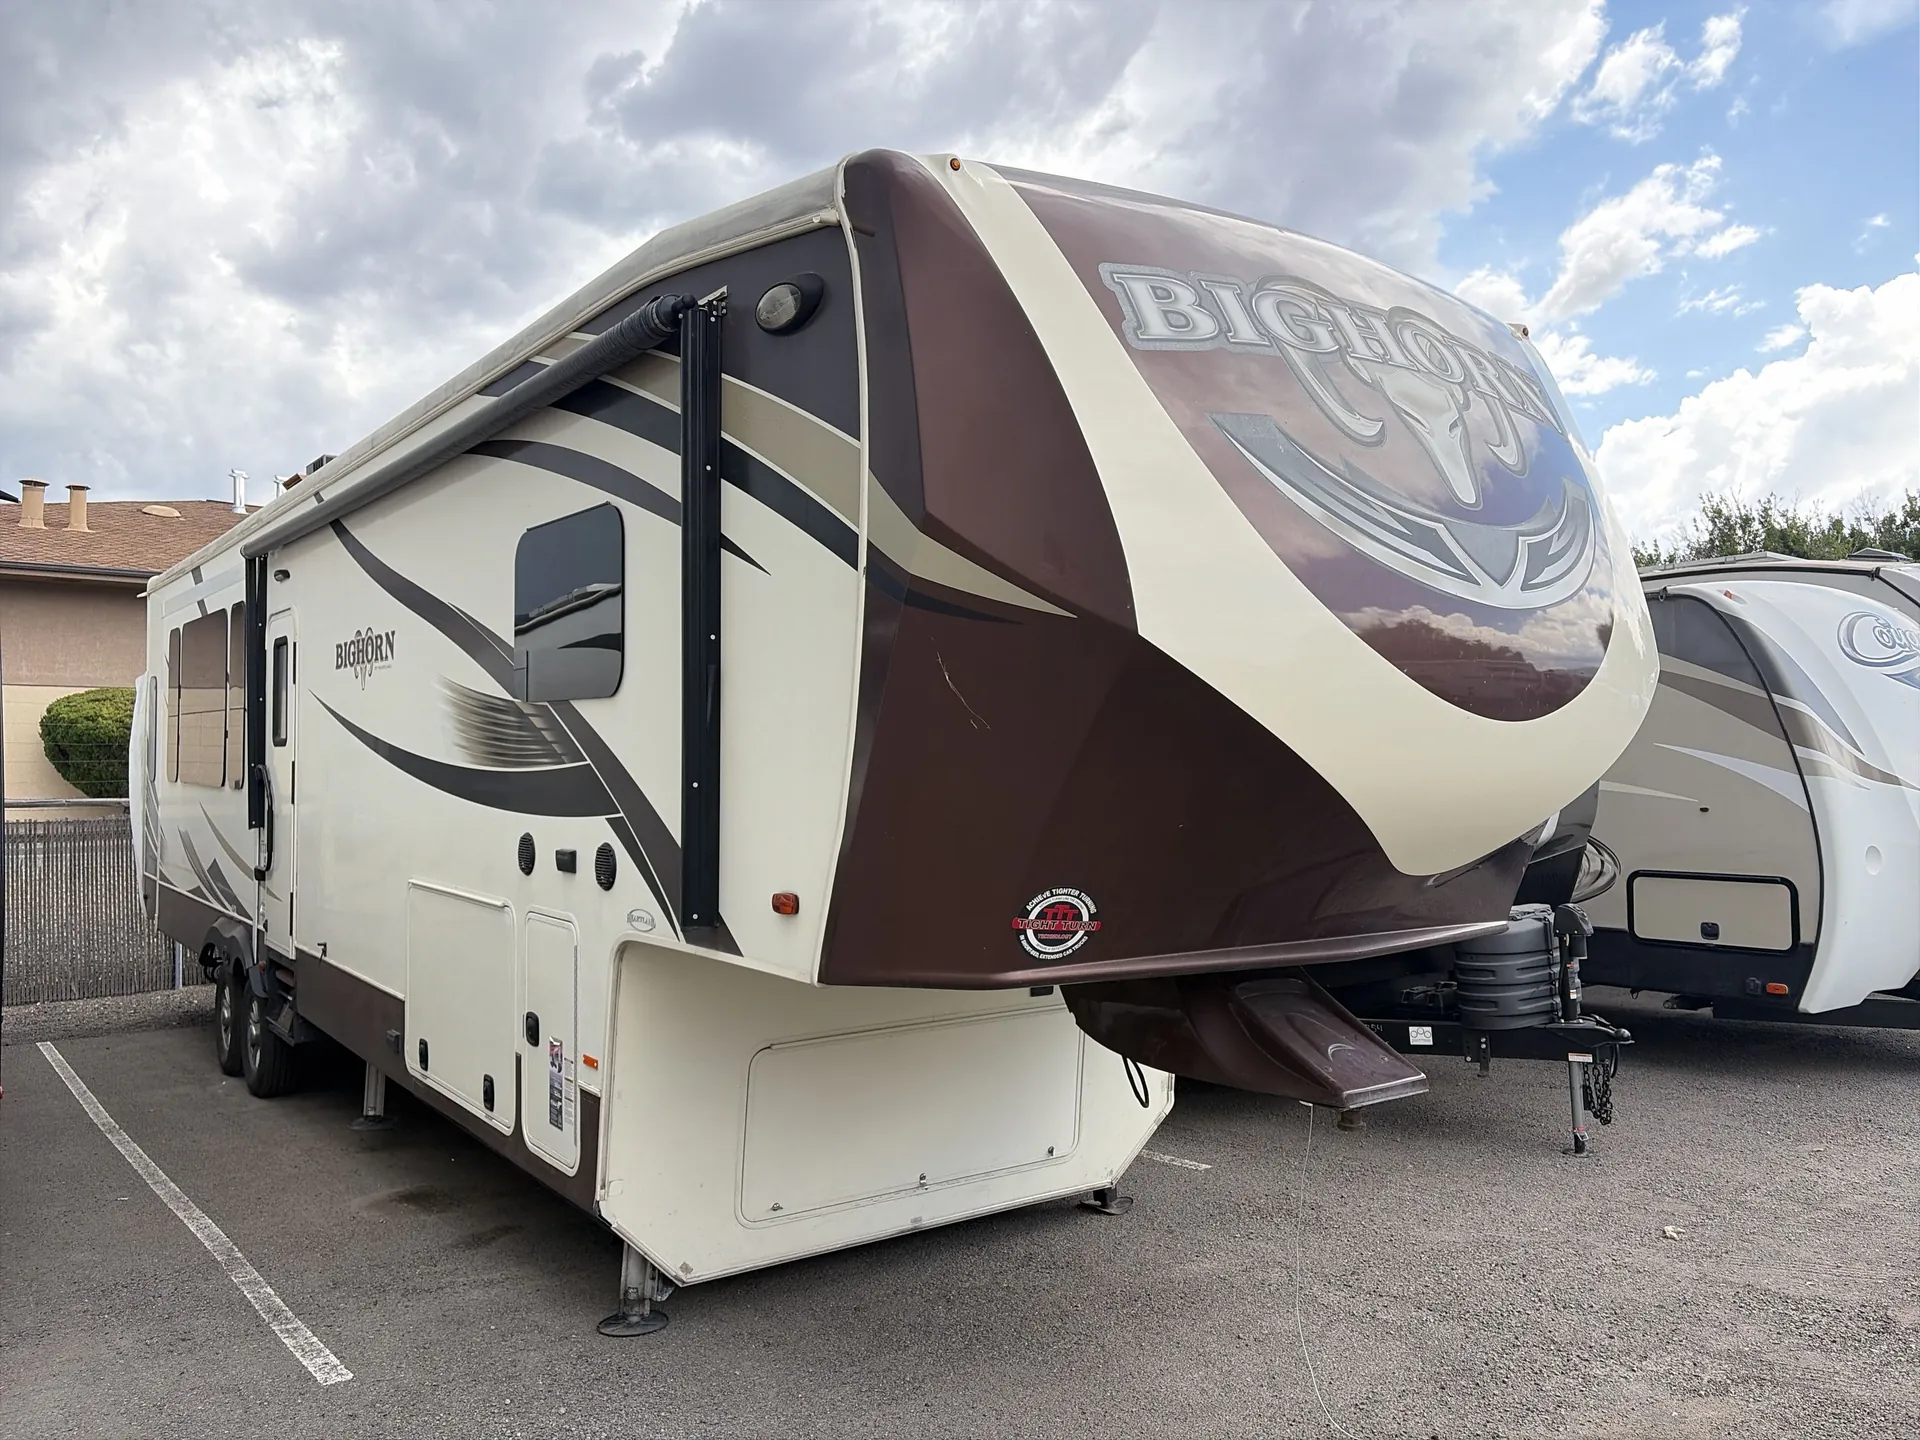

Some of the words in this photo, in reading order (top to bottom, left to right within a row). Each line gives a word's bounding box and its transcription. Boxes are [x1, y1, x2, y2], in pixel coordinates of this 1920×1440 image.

[1110, 268, 1564, 436] BIGHORN
[335, 630, 396, 670] BIGHORN
[1025, 890, 1052, 911] ACHIEVE
[1052, 888, 1080, 896] TIGHTER
[1079, 892, 1097, 914] TURNING
[1017, 919, 1058, 930] TIGHT
[1062, 920, 1098, 931] TURN
[1039, 951, 1063, 960] EXTENDED
[1063, 948, 1073, 957] CAB
[1072, 935, 1089, 951] TRUCKS
